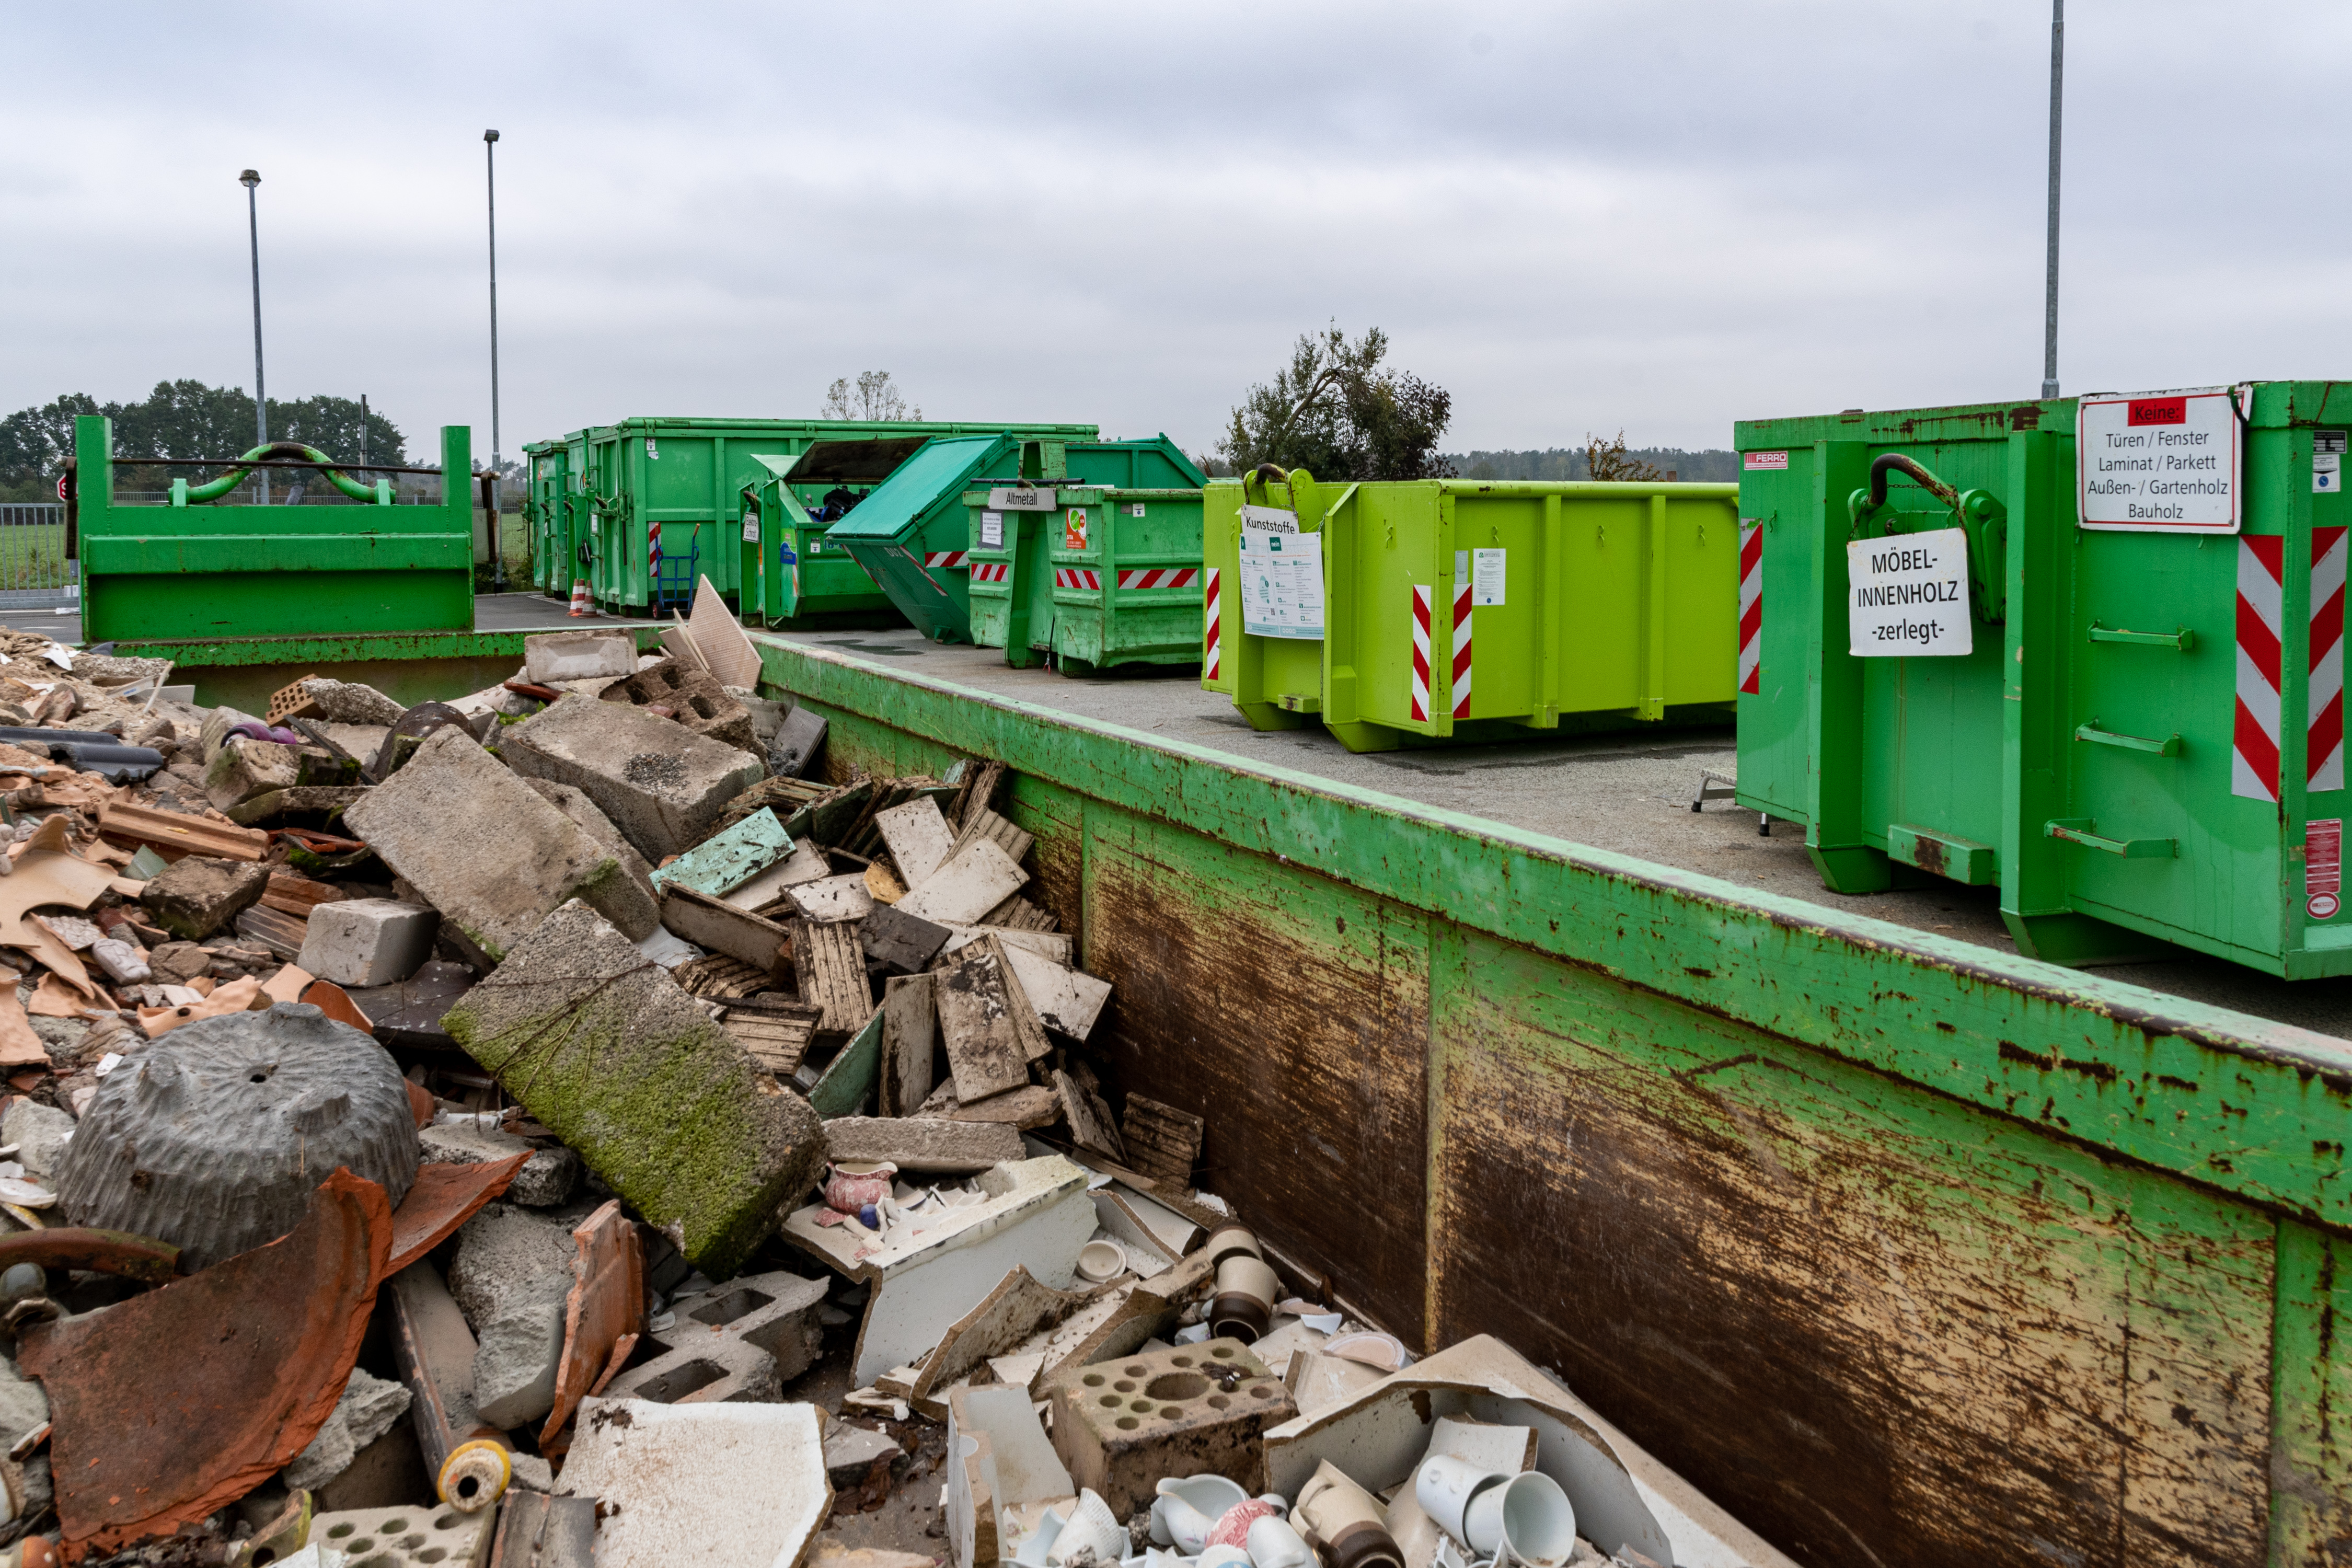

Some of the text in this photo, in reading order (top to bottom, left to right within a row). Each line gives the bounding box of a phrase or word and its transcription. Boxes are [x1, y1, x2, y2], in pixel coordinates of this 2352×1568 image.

[2135, 405, 2180, 421] Keine:
[2106, 431, 2209, 448] Türen / Fenster
[1757, 453, 1786, 462] FERRO
[2099, 454, 2217, 471] Laminat / Parkett
[2088, 478, 2228, 496] Außen- / Gartenholz
[1006, 492, 1037, 505] Altmetall
[2129, 503, 2183, 518] Bauholz
[746, 527, 757, 538] Schrott
[1246, 516, 1295, 534] Kunststoffe
[1872, 547, 1938, 574] MÖBEL-
[1858, 581, 1958, 607] INNENHOLZ
[1872, 619, 1944, 644] -zerlegt-
